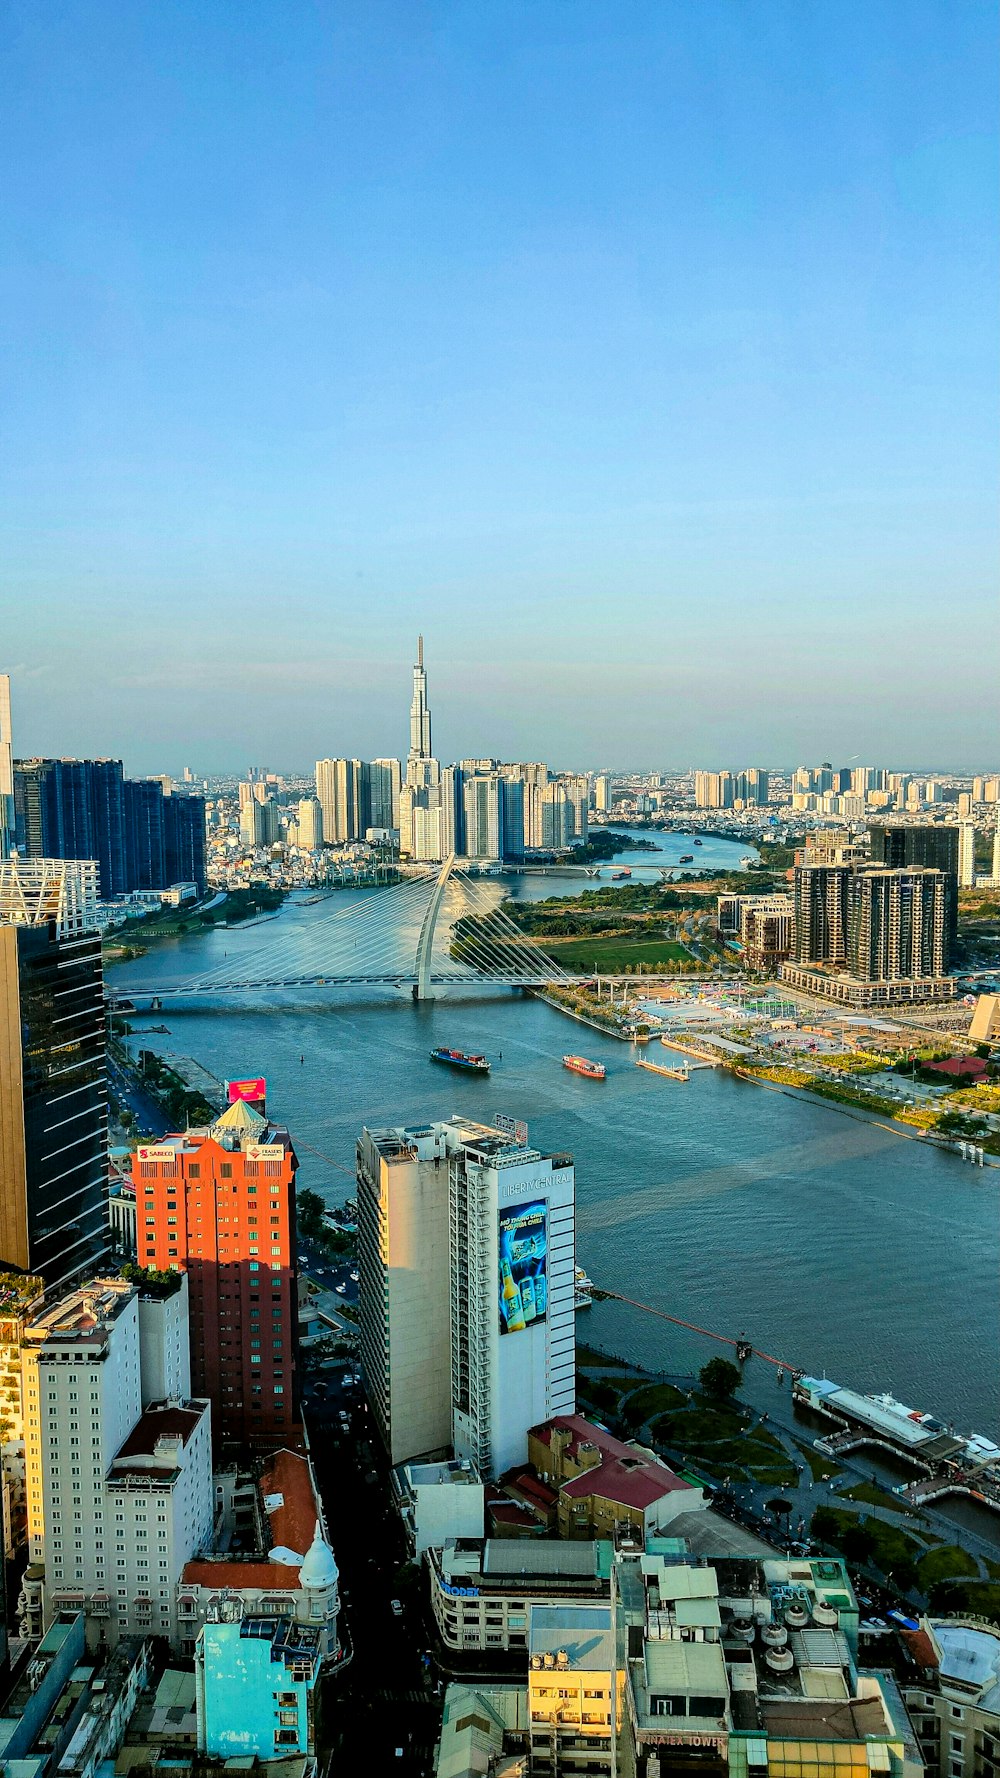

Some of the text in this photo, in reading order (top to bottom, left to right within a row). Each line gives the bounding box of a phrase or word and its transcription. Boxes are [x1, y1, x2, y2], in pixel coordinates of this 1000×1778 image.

[503, 1173, 571, 1197] LIBERTY CENTRAL
[687, 1736, 724, 1747] TOWER
